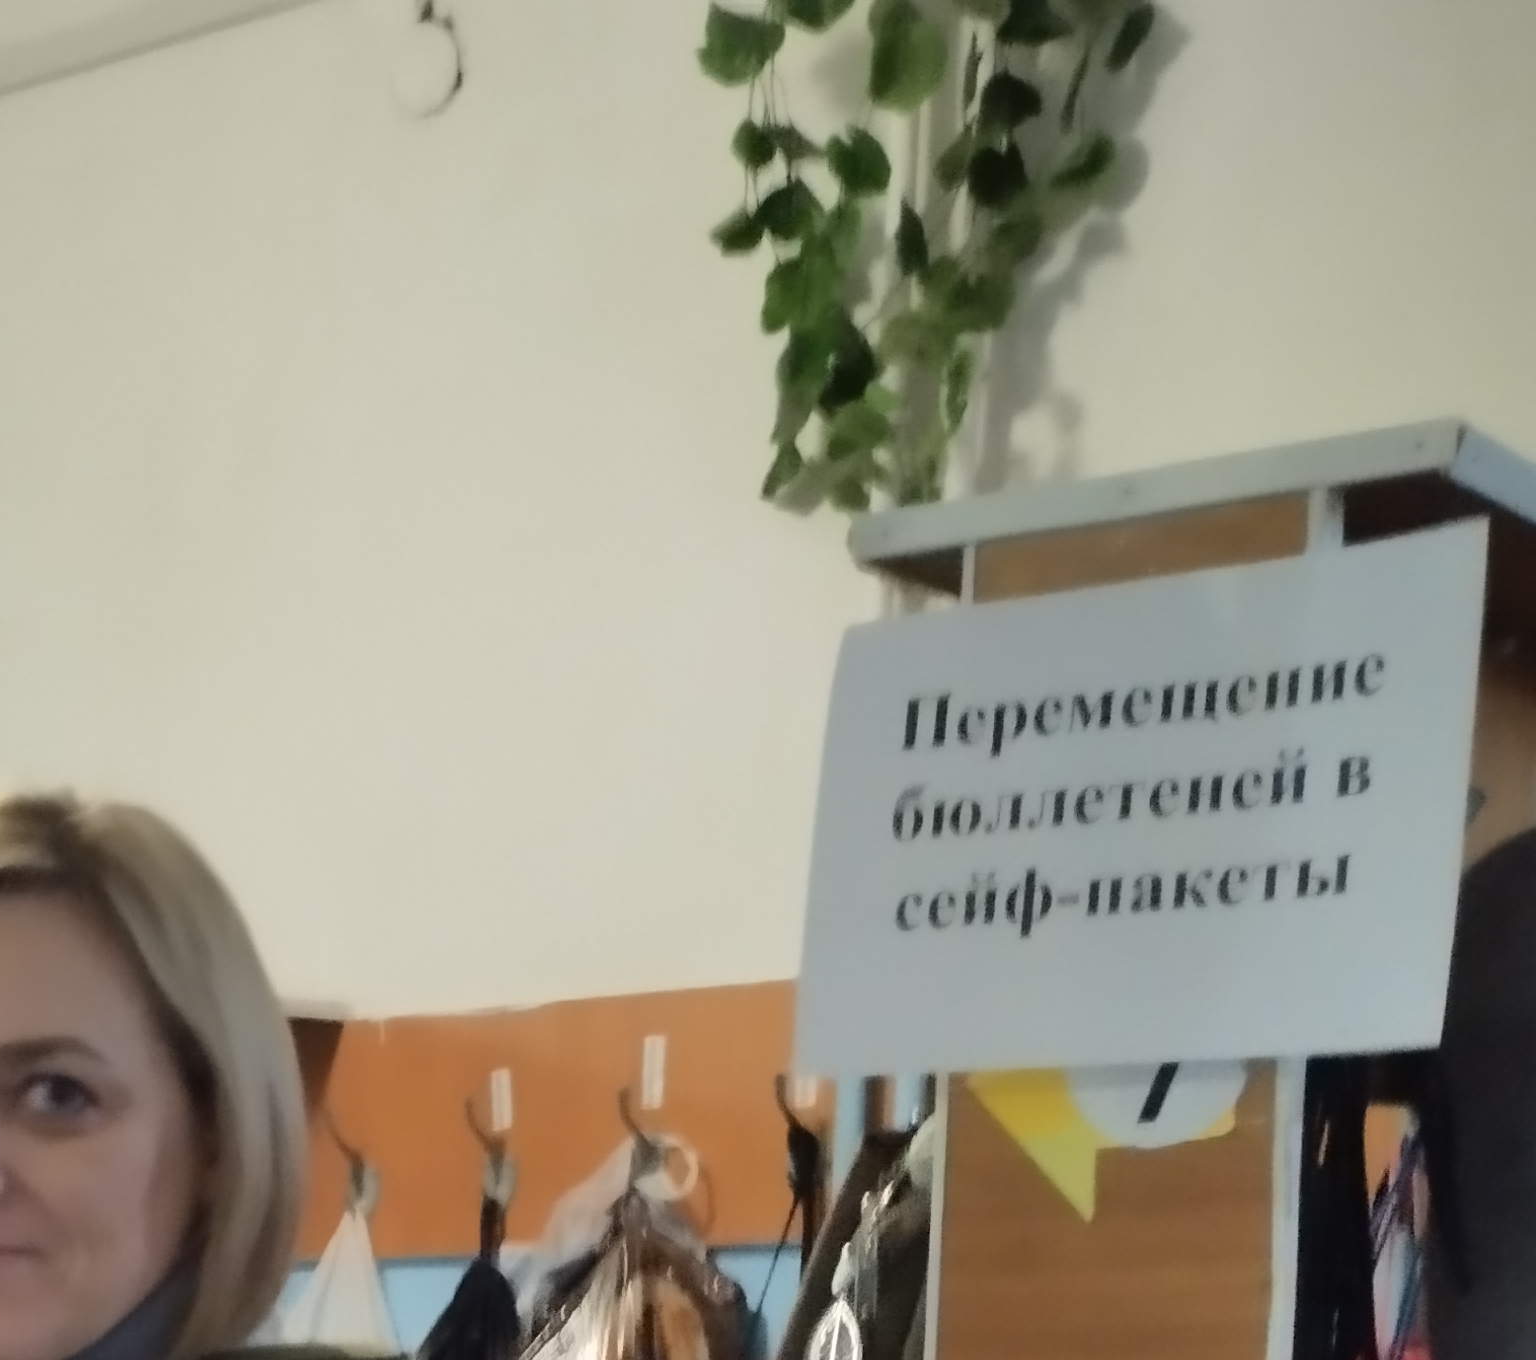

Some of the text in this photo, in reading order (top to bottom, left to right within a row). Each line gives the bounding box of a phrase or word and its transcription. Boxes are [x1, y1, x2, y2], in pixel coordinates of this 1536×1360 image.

[901, 652, 1386, 759] Перемещение
[891, 747, 1372, 843] бюллетеней в
[894, 854, 1351, 939] сейф-пакеты
